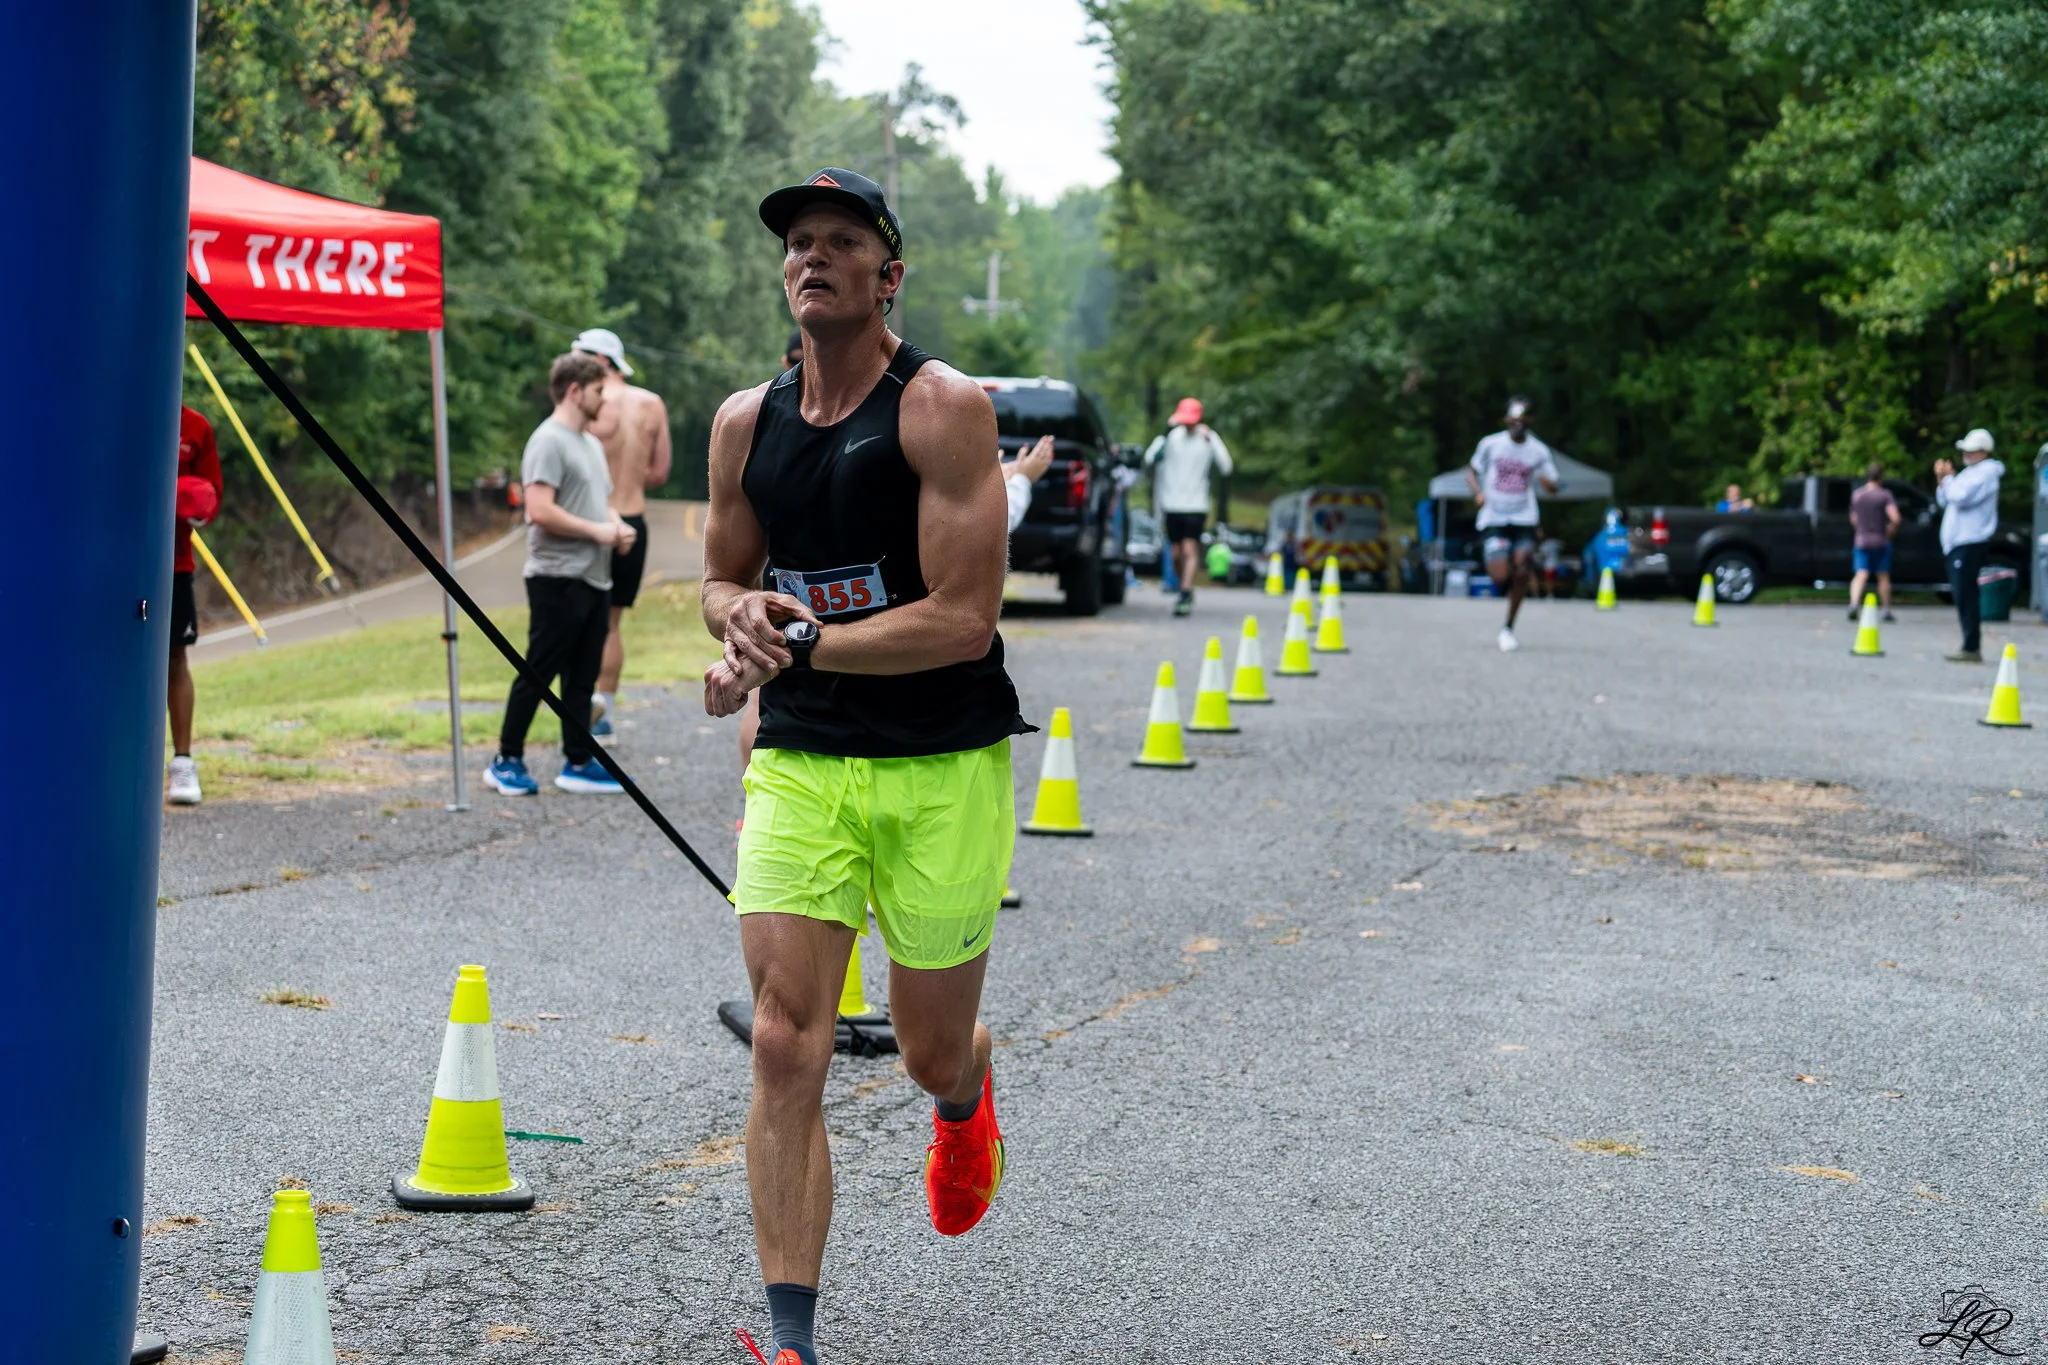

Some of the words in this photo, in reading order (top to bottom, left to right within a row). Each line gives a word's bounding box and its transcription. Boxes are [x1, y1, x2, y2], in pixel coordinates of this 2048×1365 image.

[878, 216, 898, 246] NIKE
[245, 234, 408, 298] THERE
[808, 578, 872, 613] 855
